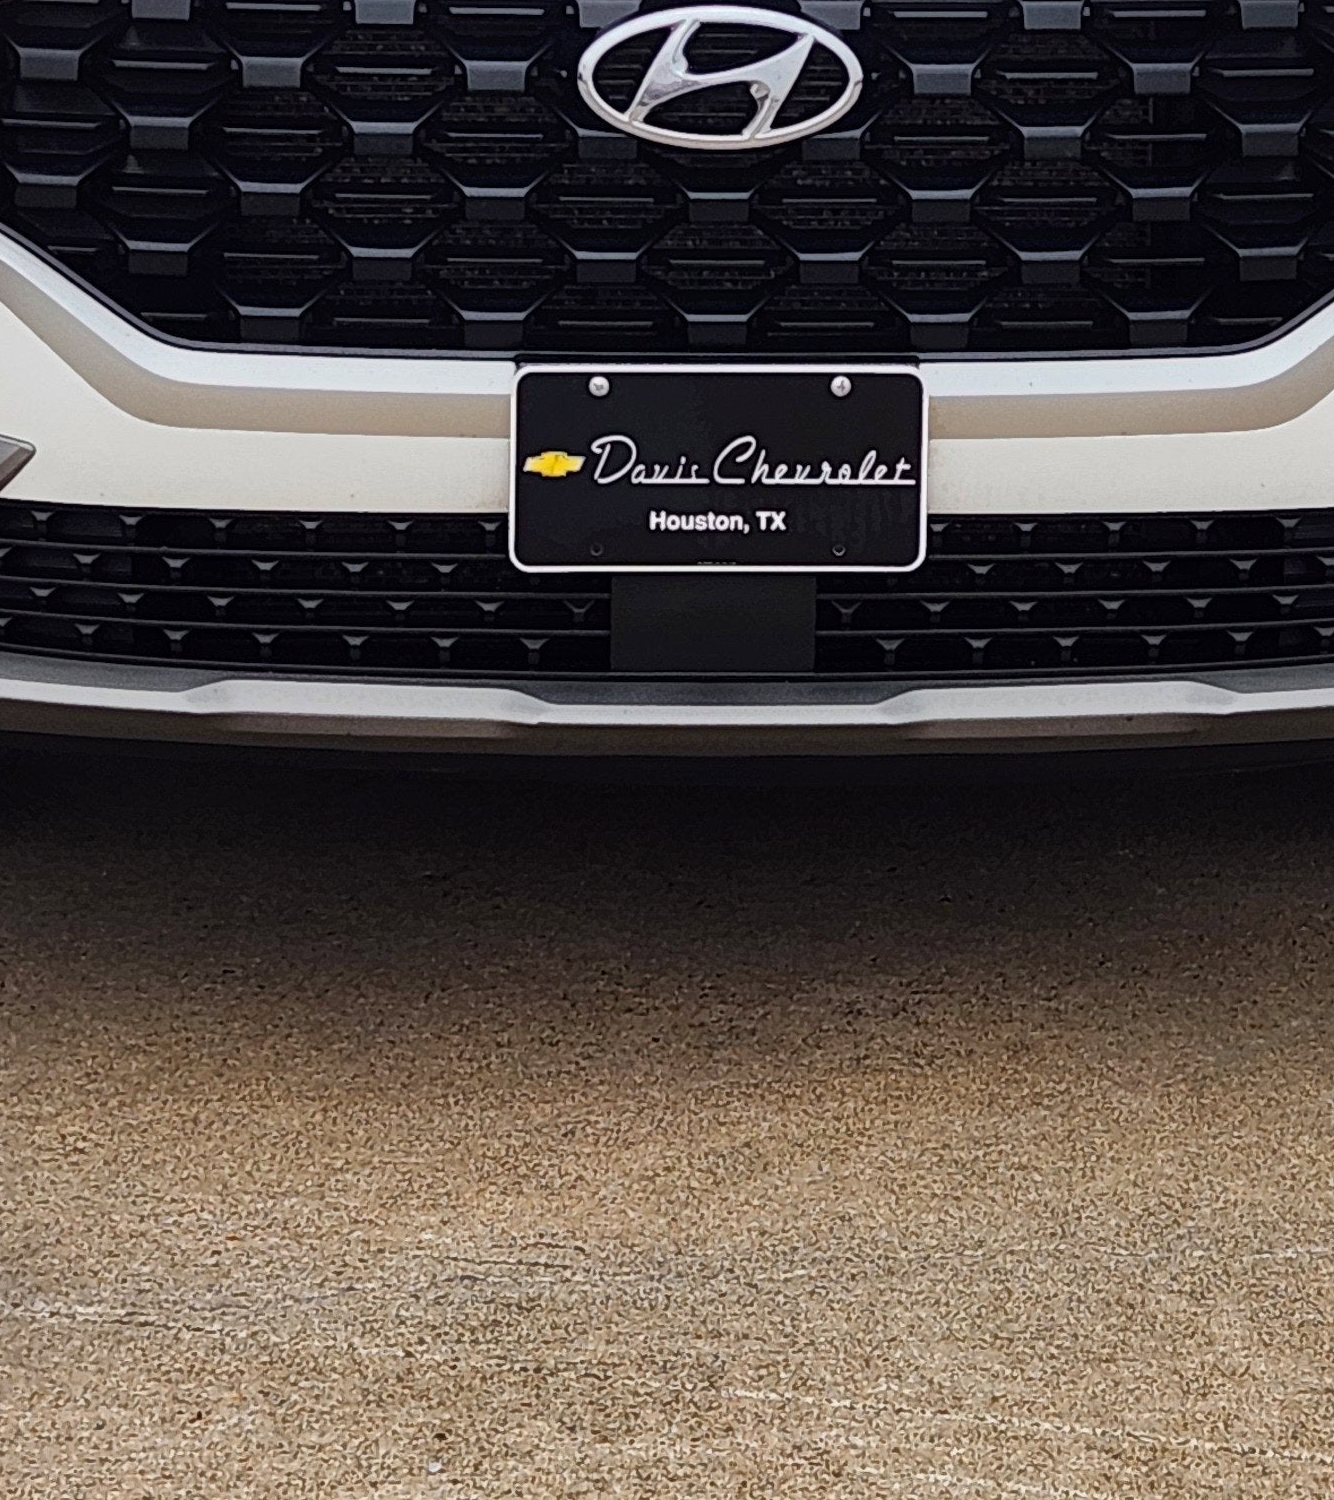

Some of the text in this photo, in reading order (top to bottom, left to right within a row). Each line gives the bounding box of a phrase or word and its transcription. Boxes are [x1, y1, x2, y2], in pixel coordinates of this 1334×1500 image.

[590, 435, 917, 485] Davis Chevrolet
[648, 510, 787, 534] Houston, TX
